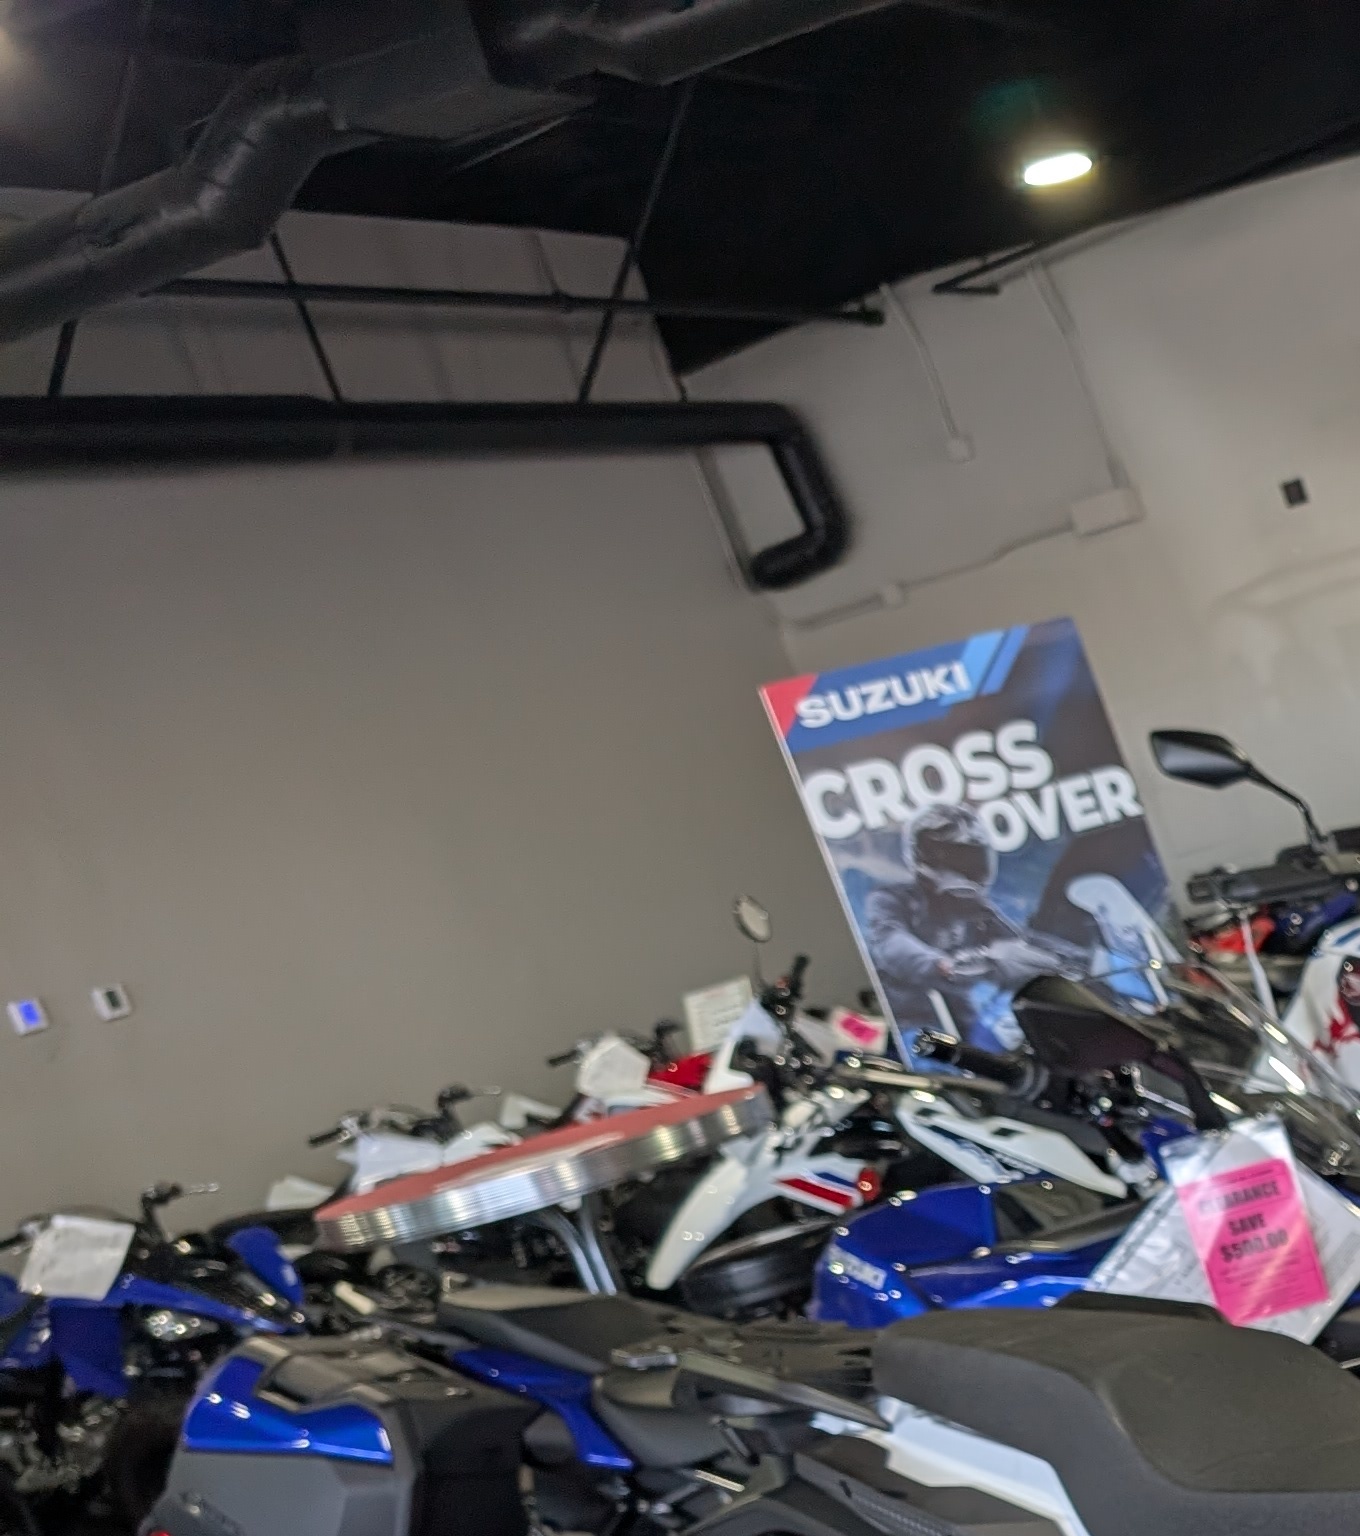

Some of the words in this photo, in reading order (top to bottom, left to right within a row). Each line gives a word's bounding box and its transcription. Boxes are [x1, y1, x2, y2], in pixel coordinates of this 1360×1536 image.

[795, 660, 972, 729] SUZUKI
[802, 719, 1053, 840] CROSS
[984, 765, 1144, 852] OVER
